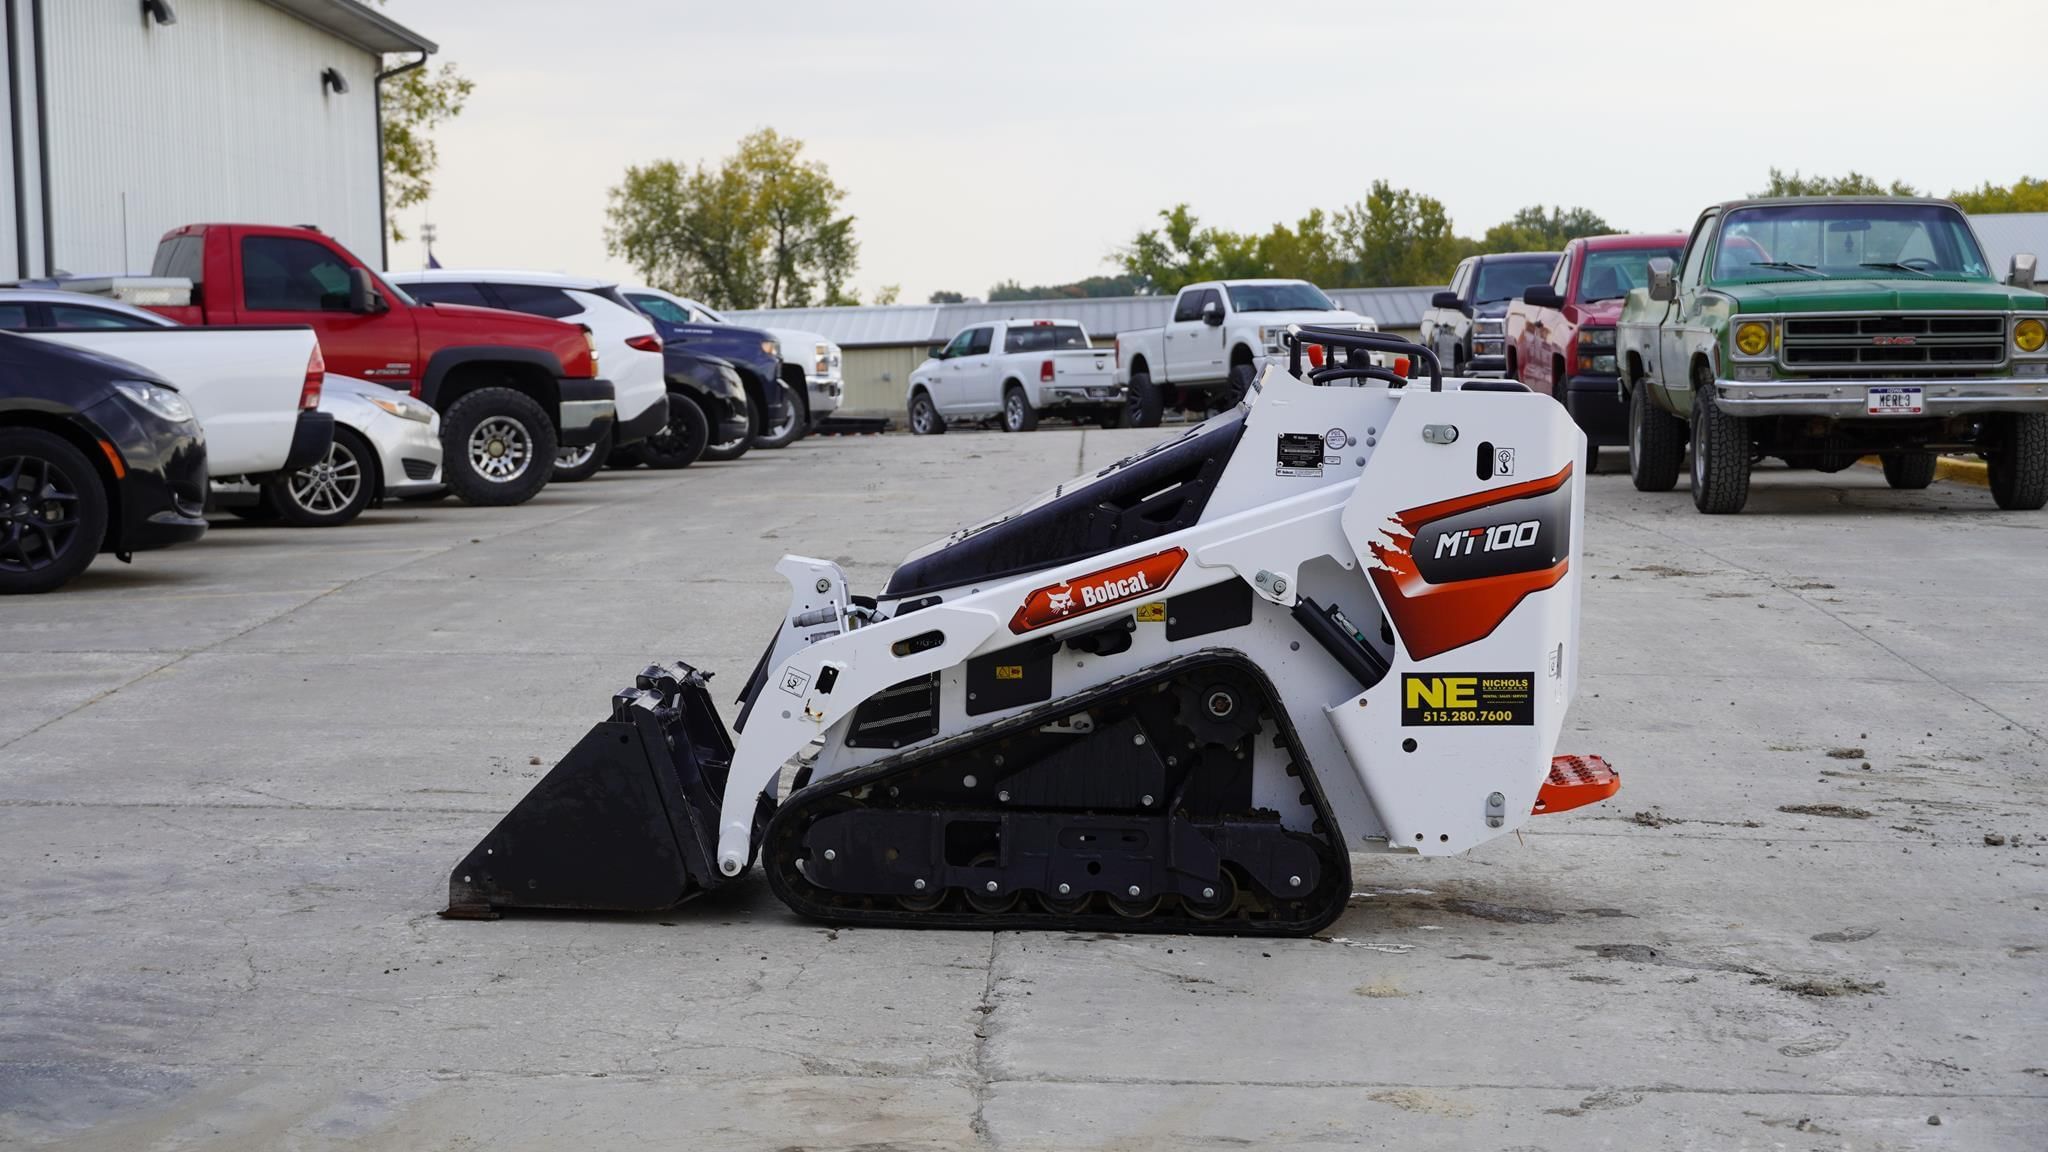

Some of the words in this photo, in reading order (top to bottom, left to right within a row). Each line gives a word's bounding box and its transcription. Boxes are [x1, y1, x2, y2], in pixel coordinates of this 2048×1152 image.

[1872, 336, 1917, 345] GMC
[1434, 520, 1540, 559] MT100
[1080, 570, 1149, 608] Bobcat
[1407, 678, 1477, 708] NE
[1482, 679, 1528, 687] NICHOLS
[1423, 710, 1512, 722] 515.280.7600
